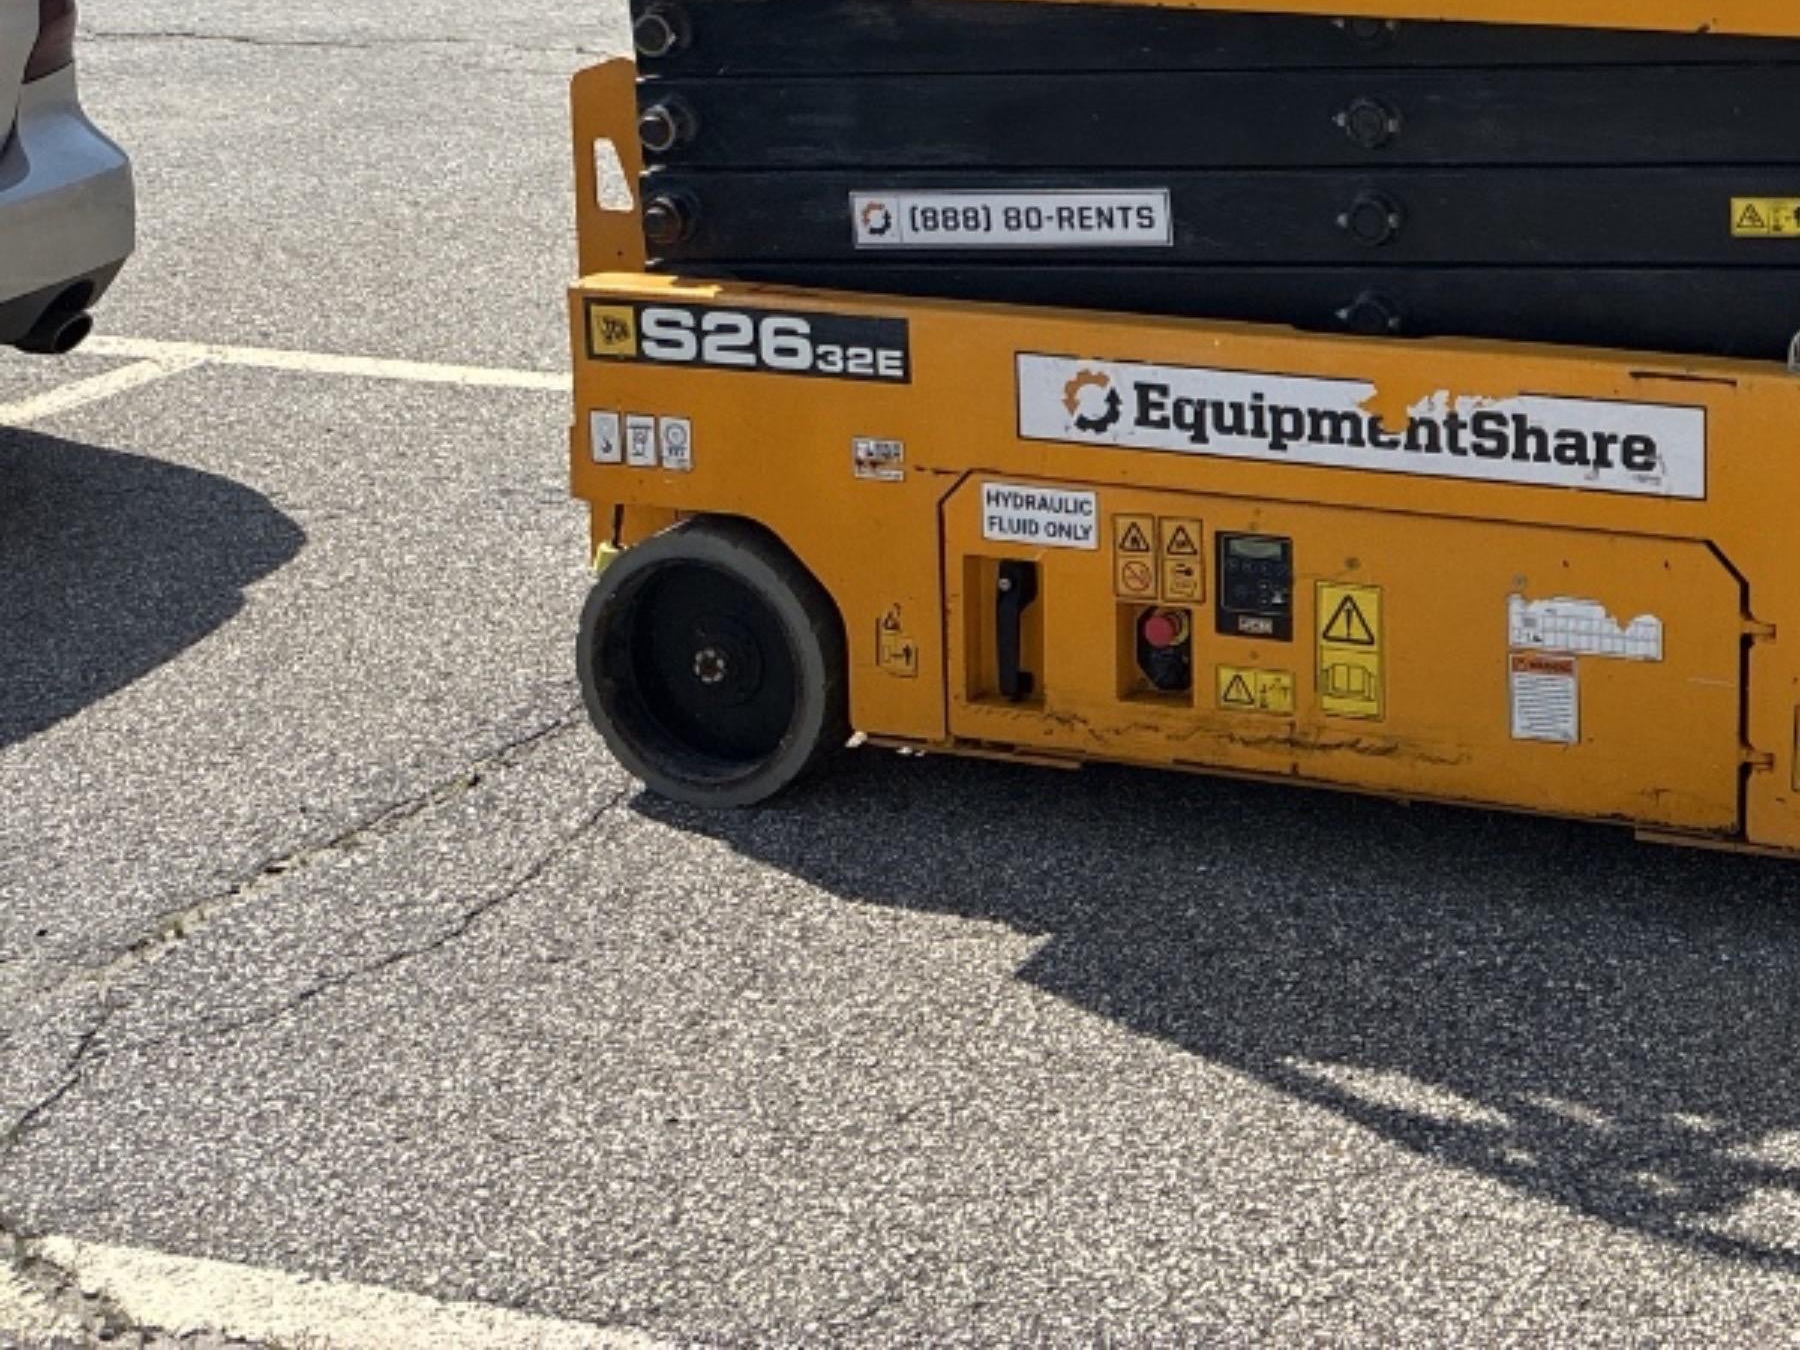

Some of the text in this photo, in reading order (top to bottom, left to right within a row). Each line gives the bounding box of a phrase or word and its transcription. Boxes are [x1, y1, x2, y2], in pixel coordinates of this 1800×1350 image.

[1003, 205, 1156, 231] 80-RENTS
[986, 490, 1093, 517] HYDRAULIC
[988, 515, 1093, 541] FLUID ONLY
